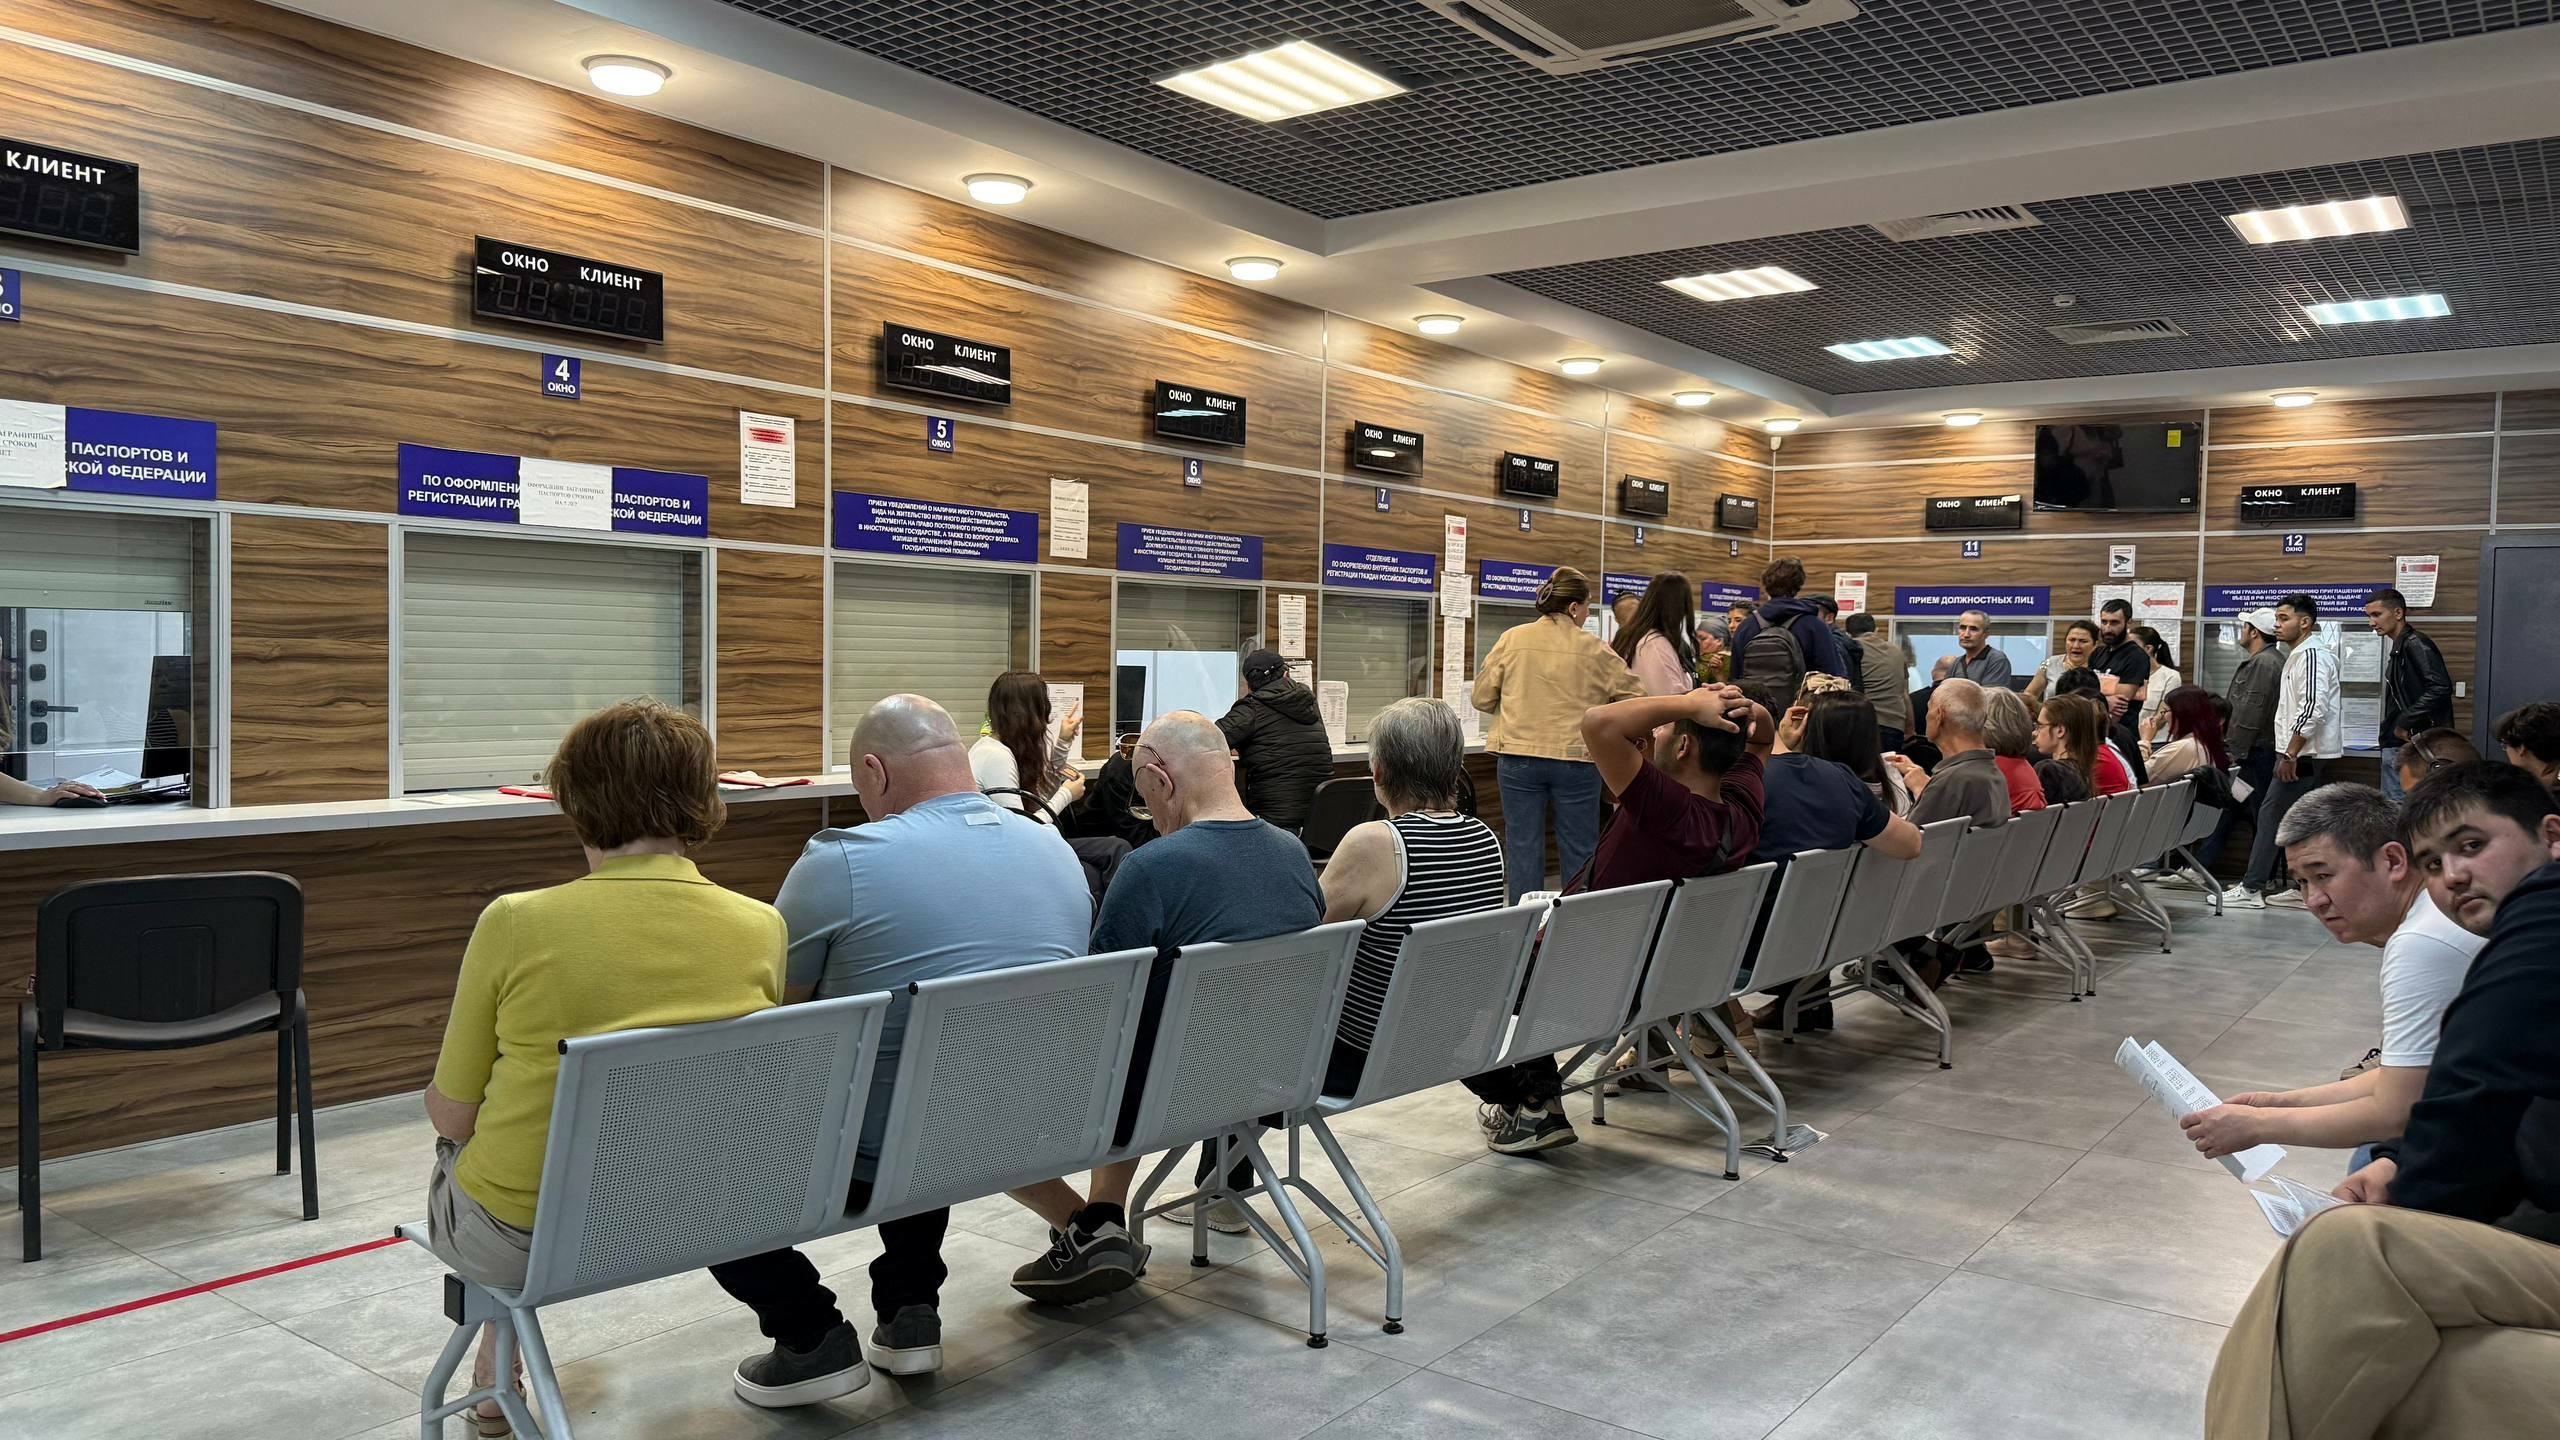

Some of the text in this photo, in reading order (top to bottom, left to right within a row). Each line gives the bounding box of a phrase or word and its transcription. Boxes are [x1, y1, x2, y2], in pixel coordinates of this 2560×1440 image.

[6, 150, 106, 185] КЛИЕНТ
[501, 251, 643, 290] ОКНО КЛИЕНТ
[902, 333, 996, 363] ОКНО КЛИЕНТ
[555, 359, 570, 381] 4
[547, 382, 576, 394] ОКНО
[1168, 389, 1237, 411] ОКНО КЛИЕНТ
[936, 420, 947, 438] 5
[931, 439, 951, 448] ОКНО
[1365, 428, 1417, 446] ОКНО КЛИЕНТ
[72, 441, 189, 464] ПАСПОРТОВ И
[1190, 461, 1198, 476] 6
[1512, 458, 1554, 472] ОКНО КЛИЕНТ
[107, 463, 207, 484] ФЕДЕРАЦИИ
[422, 474, 441, 486] ПО
[1186, 476, 1201, 485] ОКНО
[408, 490, 497, 508] РЕГИСТРАЦИИ
[1380, 489, 1386, 502] 7
[2254, 488, 2341, 498] ОКНО КЛИЕНТ
[615, 493, 690, 510] ПАСПОРТОВ И
[1936, 499, 2008, 508] ОКНО КЛИЕНТ
[638, 512, 702, 526] ФЕДЕРАЦИИ
[1523, 510, 1528, 522] 8
[1965, 541, 1978, 551] 11
[2286, 535, 2303, 546] 12
[1909, 596, 2033, 605] ПРИЕМ ДОЛЖНОСТНЫХ ЛИЦ
